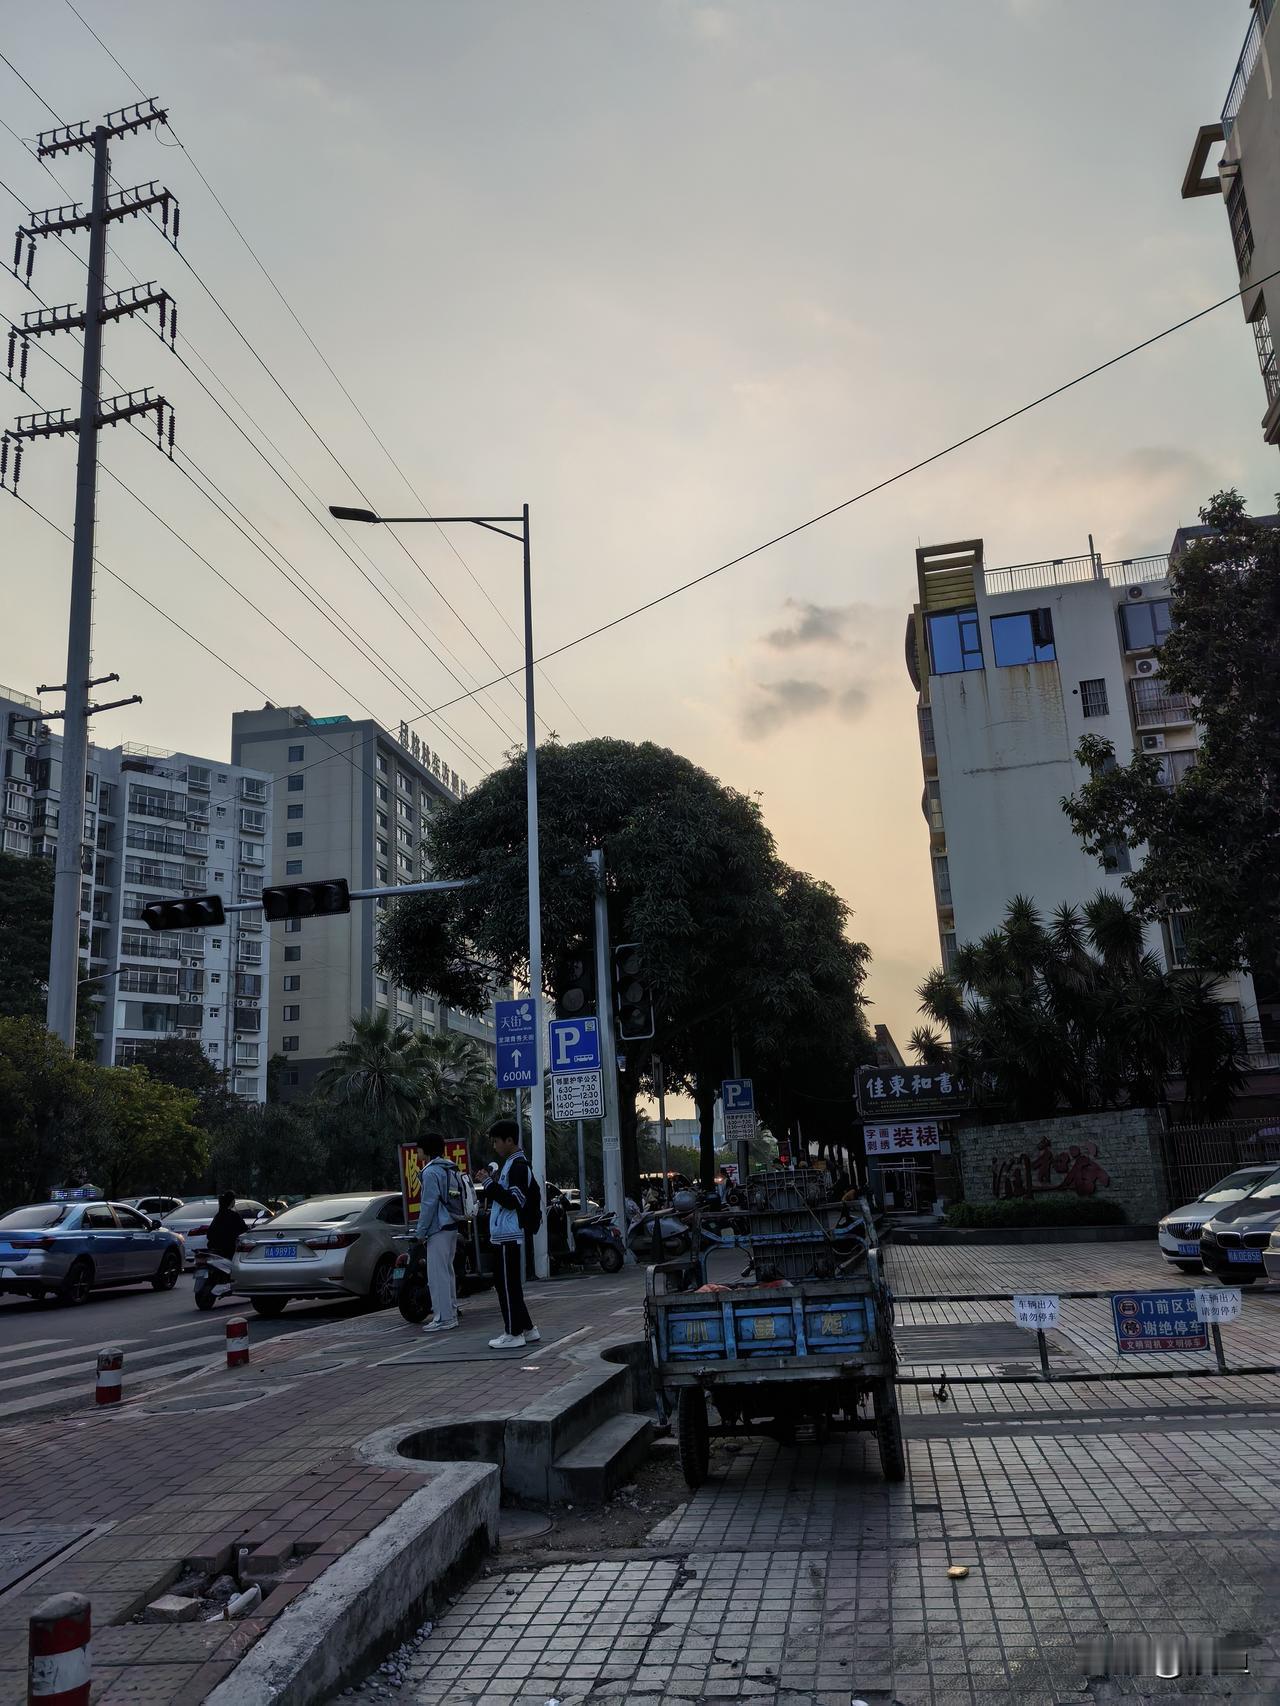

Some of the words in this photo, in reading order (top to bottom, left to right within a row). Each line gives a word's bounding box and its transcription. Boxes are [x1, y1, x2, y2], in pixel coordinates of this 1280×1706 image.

[501, 1015, 521, 1029] 天街
[555, 1027, 580, 1064] P
[503, 1070, 531, 1082] 600M
[726, 1084, 741, 1107] P
[893, 1126, 938, 1148] 装裱
[1018, 1299, 1056, 1310] 车辆出入
[1201, 1293, 1239, 1304] 车辆出入
[1019, 1311, 1057, 1322] 请勿停车
[1201, 1306, 1239, 1317] 请勿停车
[1142, 1319, 1203, 1337] 谢绝停车
